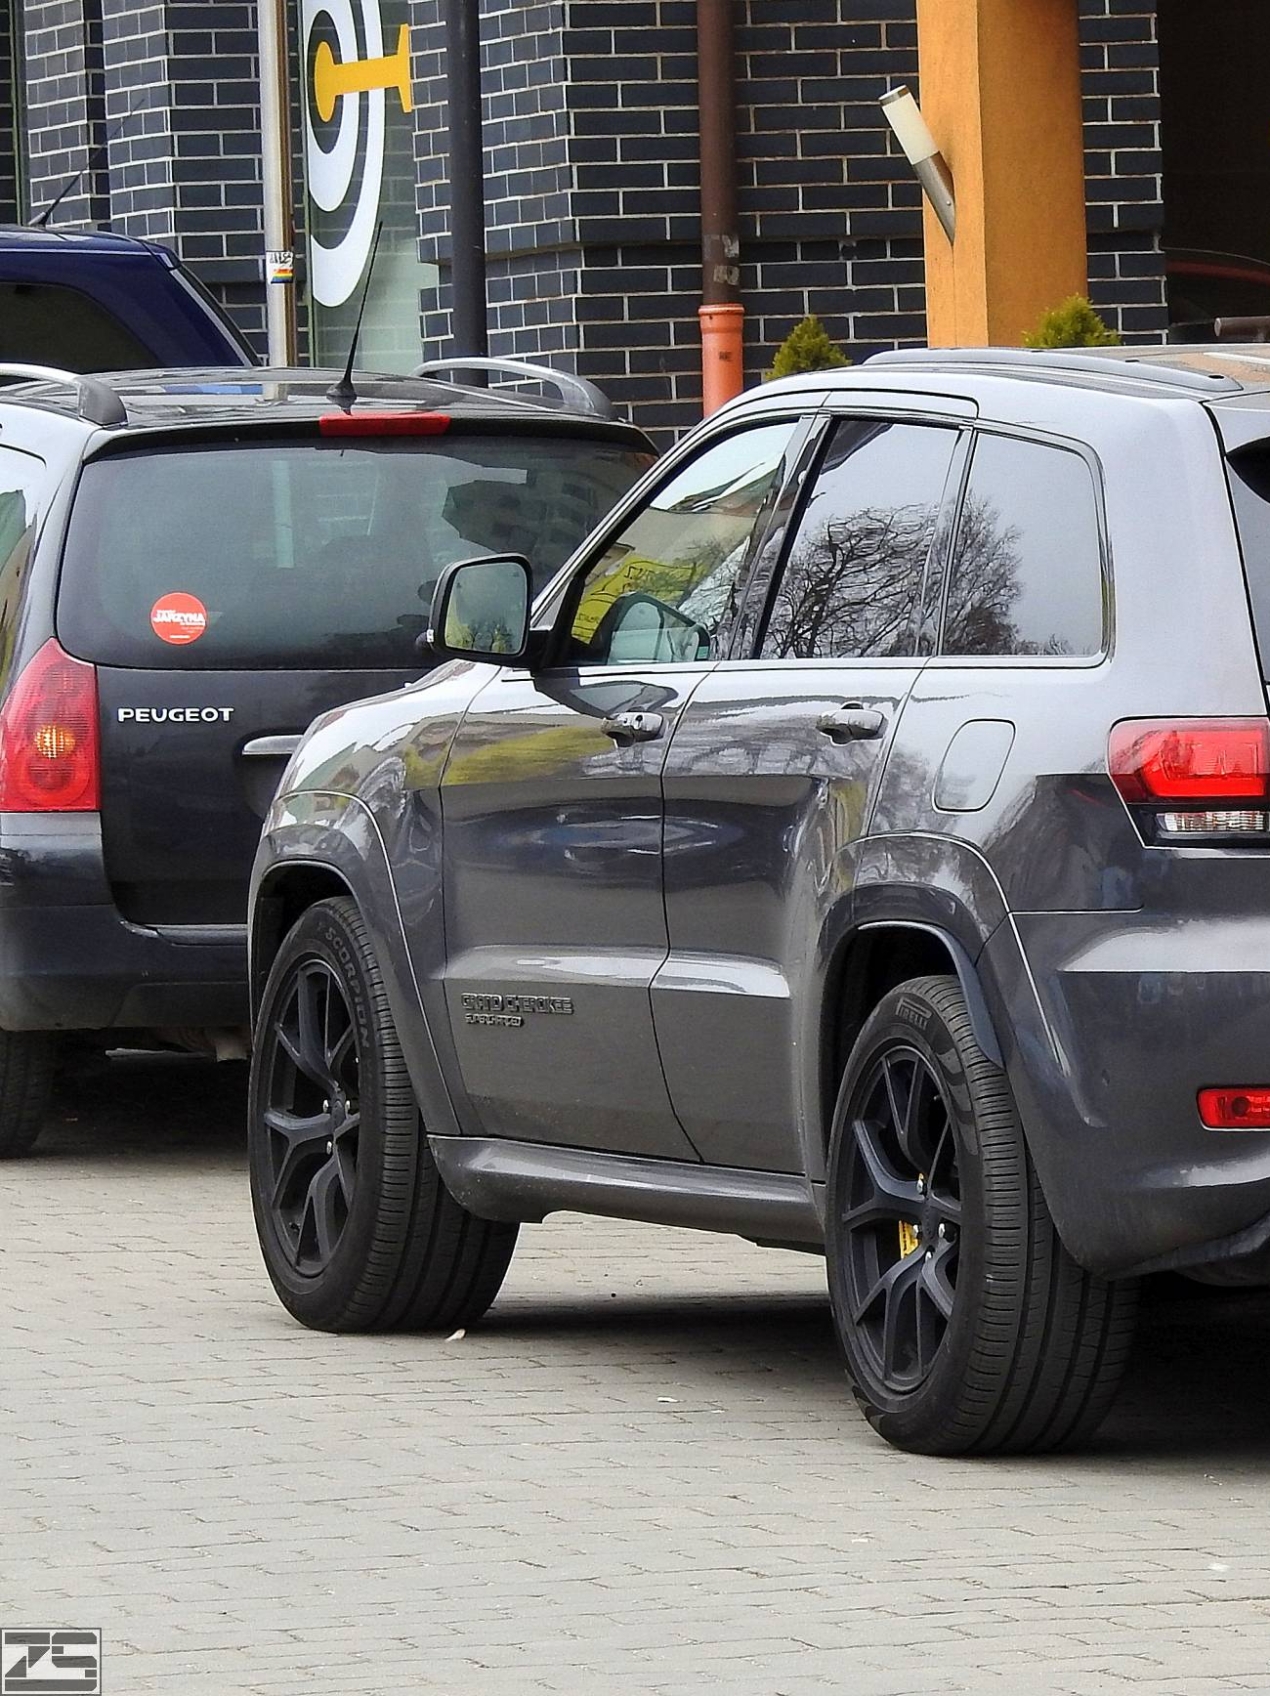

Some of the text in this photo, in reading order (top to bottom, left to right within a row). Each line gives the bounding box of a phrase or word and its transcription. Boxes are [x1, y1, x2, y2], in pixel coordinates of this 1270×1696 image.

[117, 706, 234, 723] PEUGEOT
[325, 926, 370, 1049] SCORPION
[461, 992, 574, 1014] GRAND CHEROKEE
[895, 996, 932, 1031] PIRELLI
